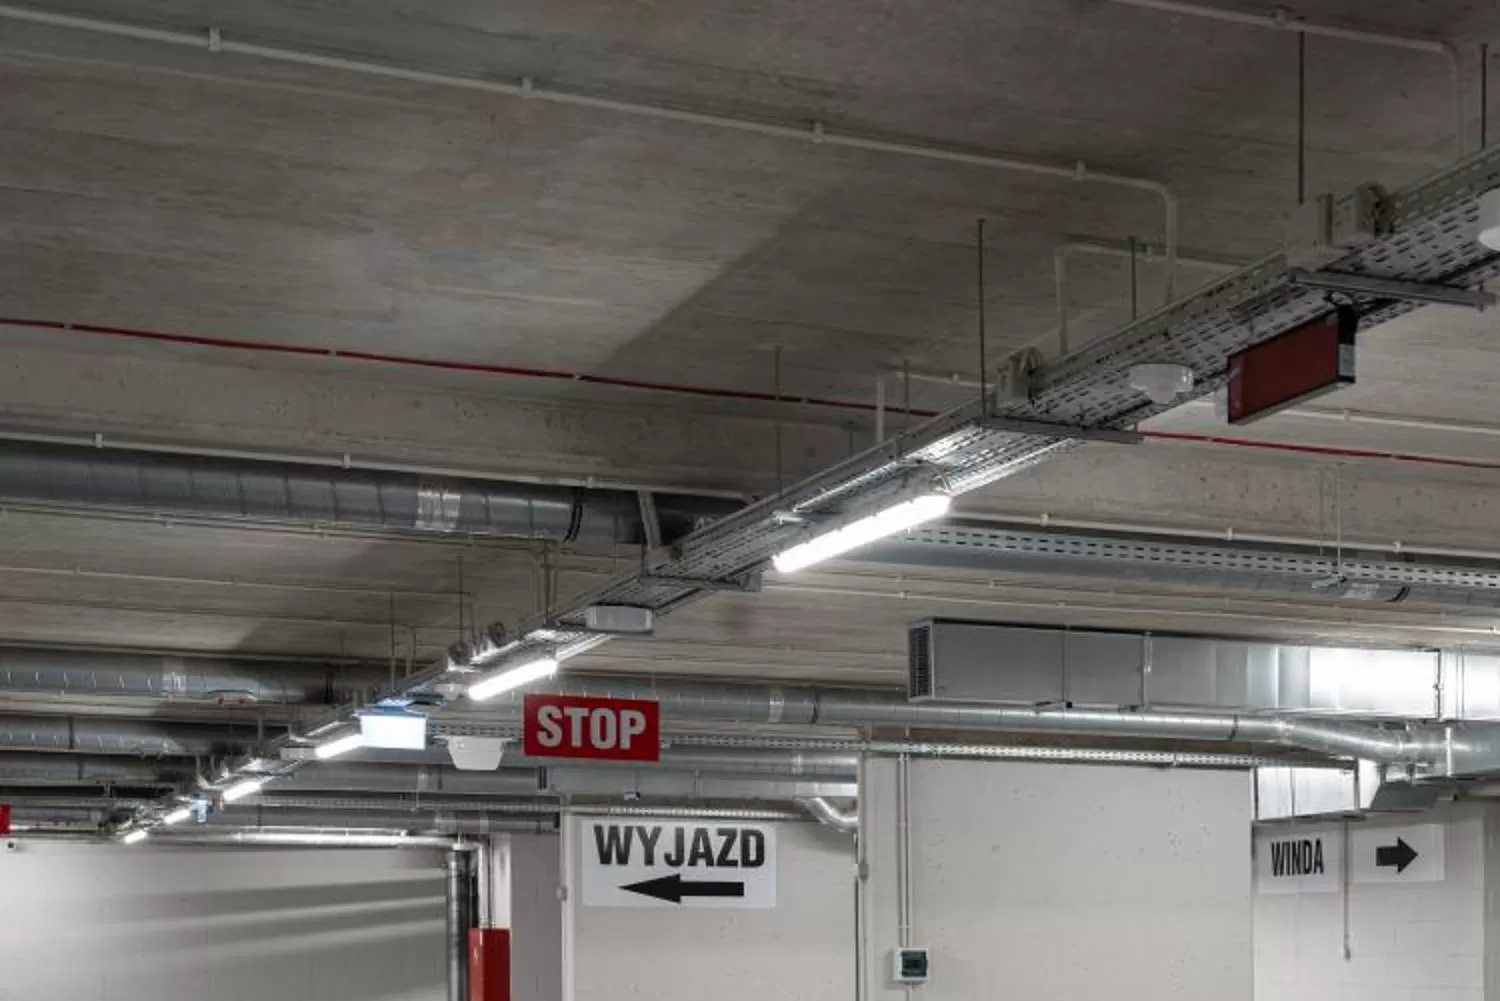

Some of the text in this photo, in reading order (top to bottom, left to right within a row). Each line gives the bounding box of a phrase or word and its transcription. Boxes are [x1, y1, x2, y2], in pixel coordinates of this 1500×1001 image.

[537, 705, 647, 750] STOP
[593, 824, 766, 869] WYJAZD
[1271, 837, 1325, 877] WINDA
